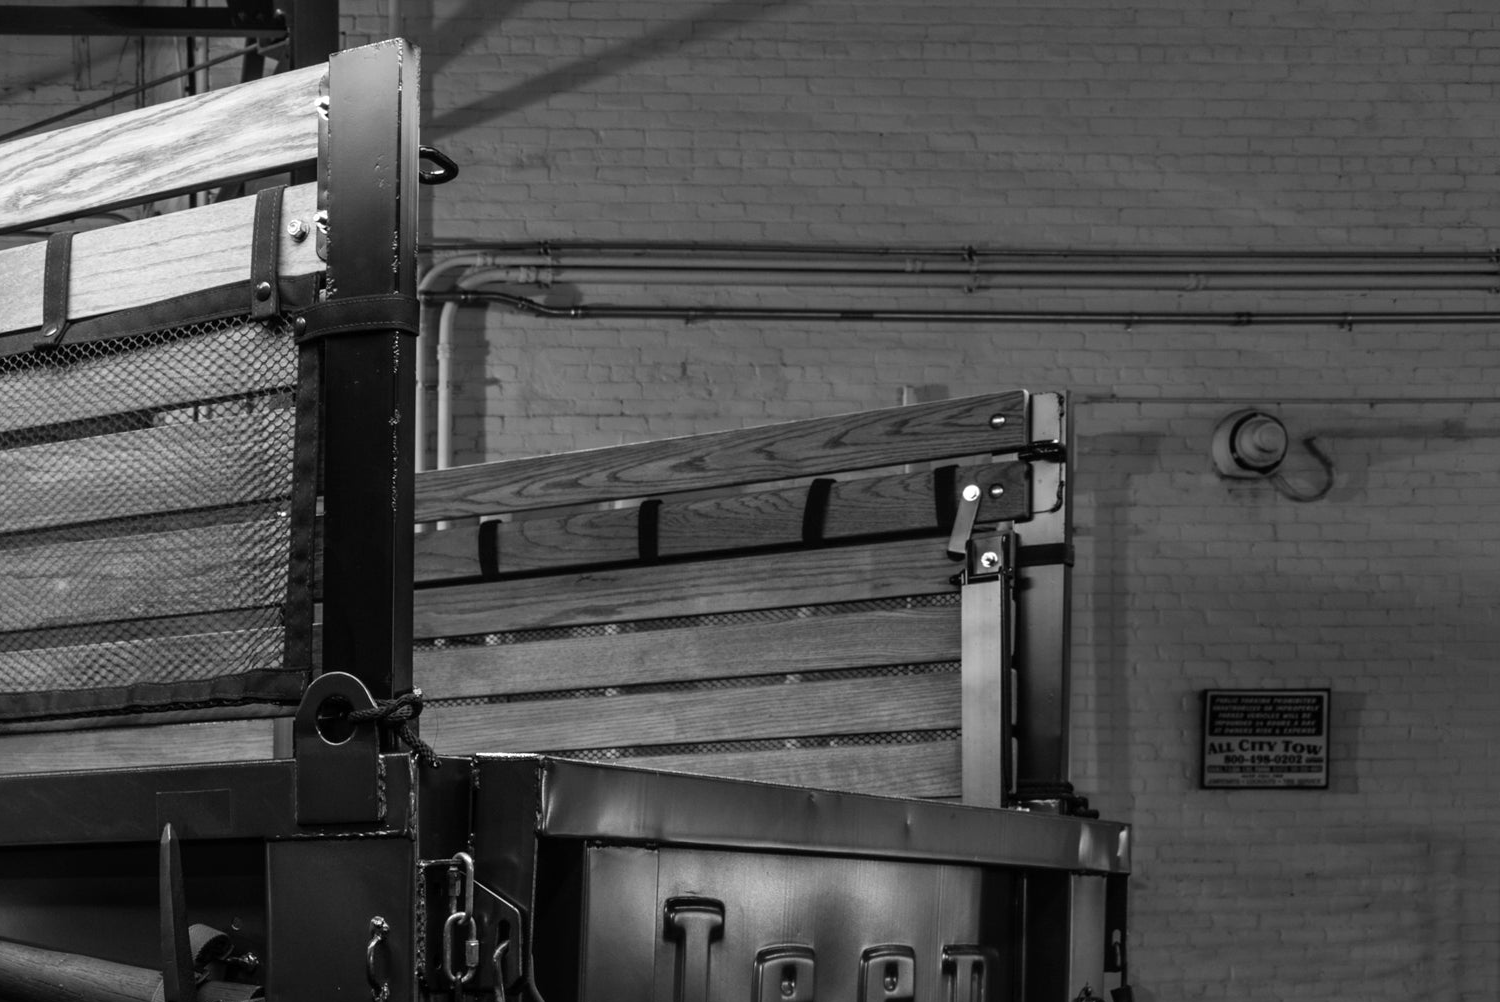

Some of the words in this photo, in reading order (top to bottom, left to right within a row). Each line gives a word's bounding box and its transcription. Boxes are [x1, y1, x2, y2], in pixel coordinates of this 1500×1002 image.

[1208, 741, 1235, 755] ALL
[1239, 739, 1278, 753] CITY
[1282, 740, 1323, 755] TOW
